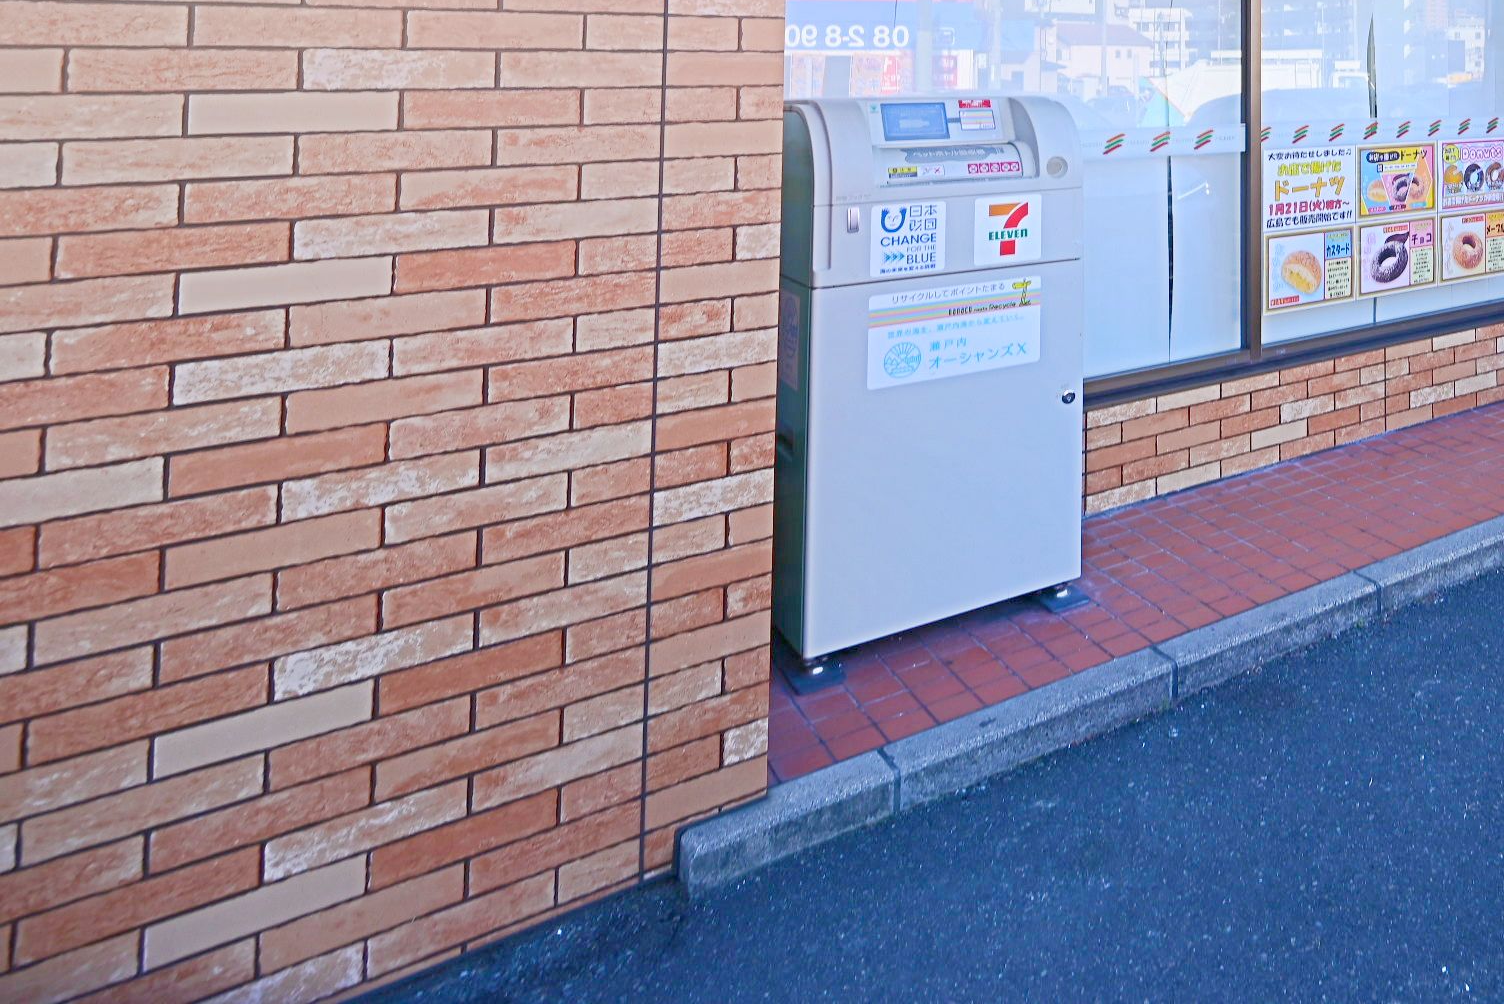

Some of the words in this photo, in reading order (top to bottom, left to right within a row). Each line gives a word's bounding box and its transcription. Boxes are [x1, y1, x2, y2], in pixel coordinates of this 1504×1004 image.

[1274, 176, 1345, 202] ドーナツ
[909, 204, 937, 217] 日本
[880, 232, 936, 247] CHANGE
[1411, 232, 1432, 245] チョコ
[1326, 243, 1350, 257] カスタード
[906, 251, 936, 265] BLUE
[892, 283, 1006, 305] リサイクルしてポイントたまる
[929, 337, 968, 352] 瀬戸内
